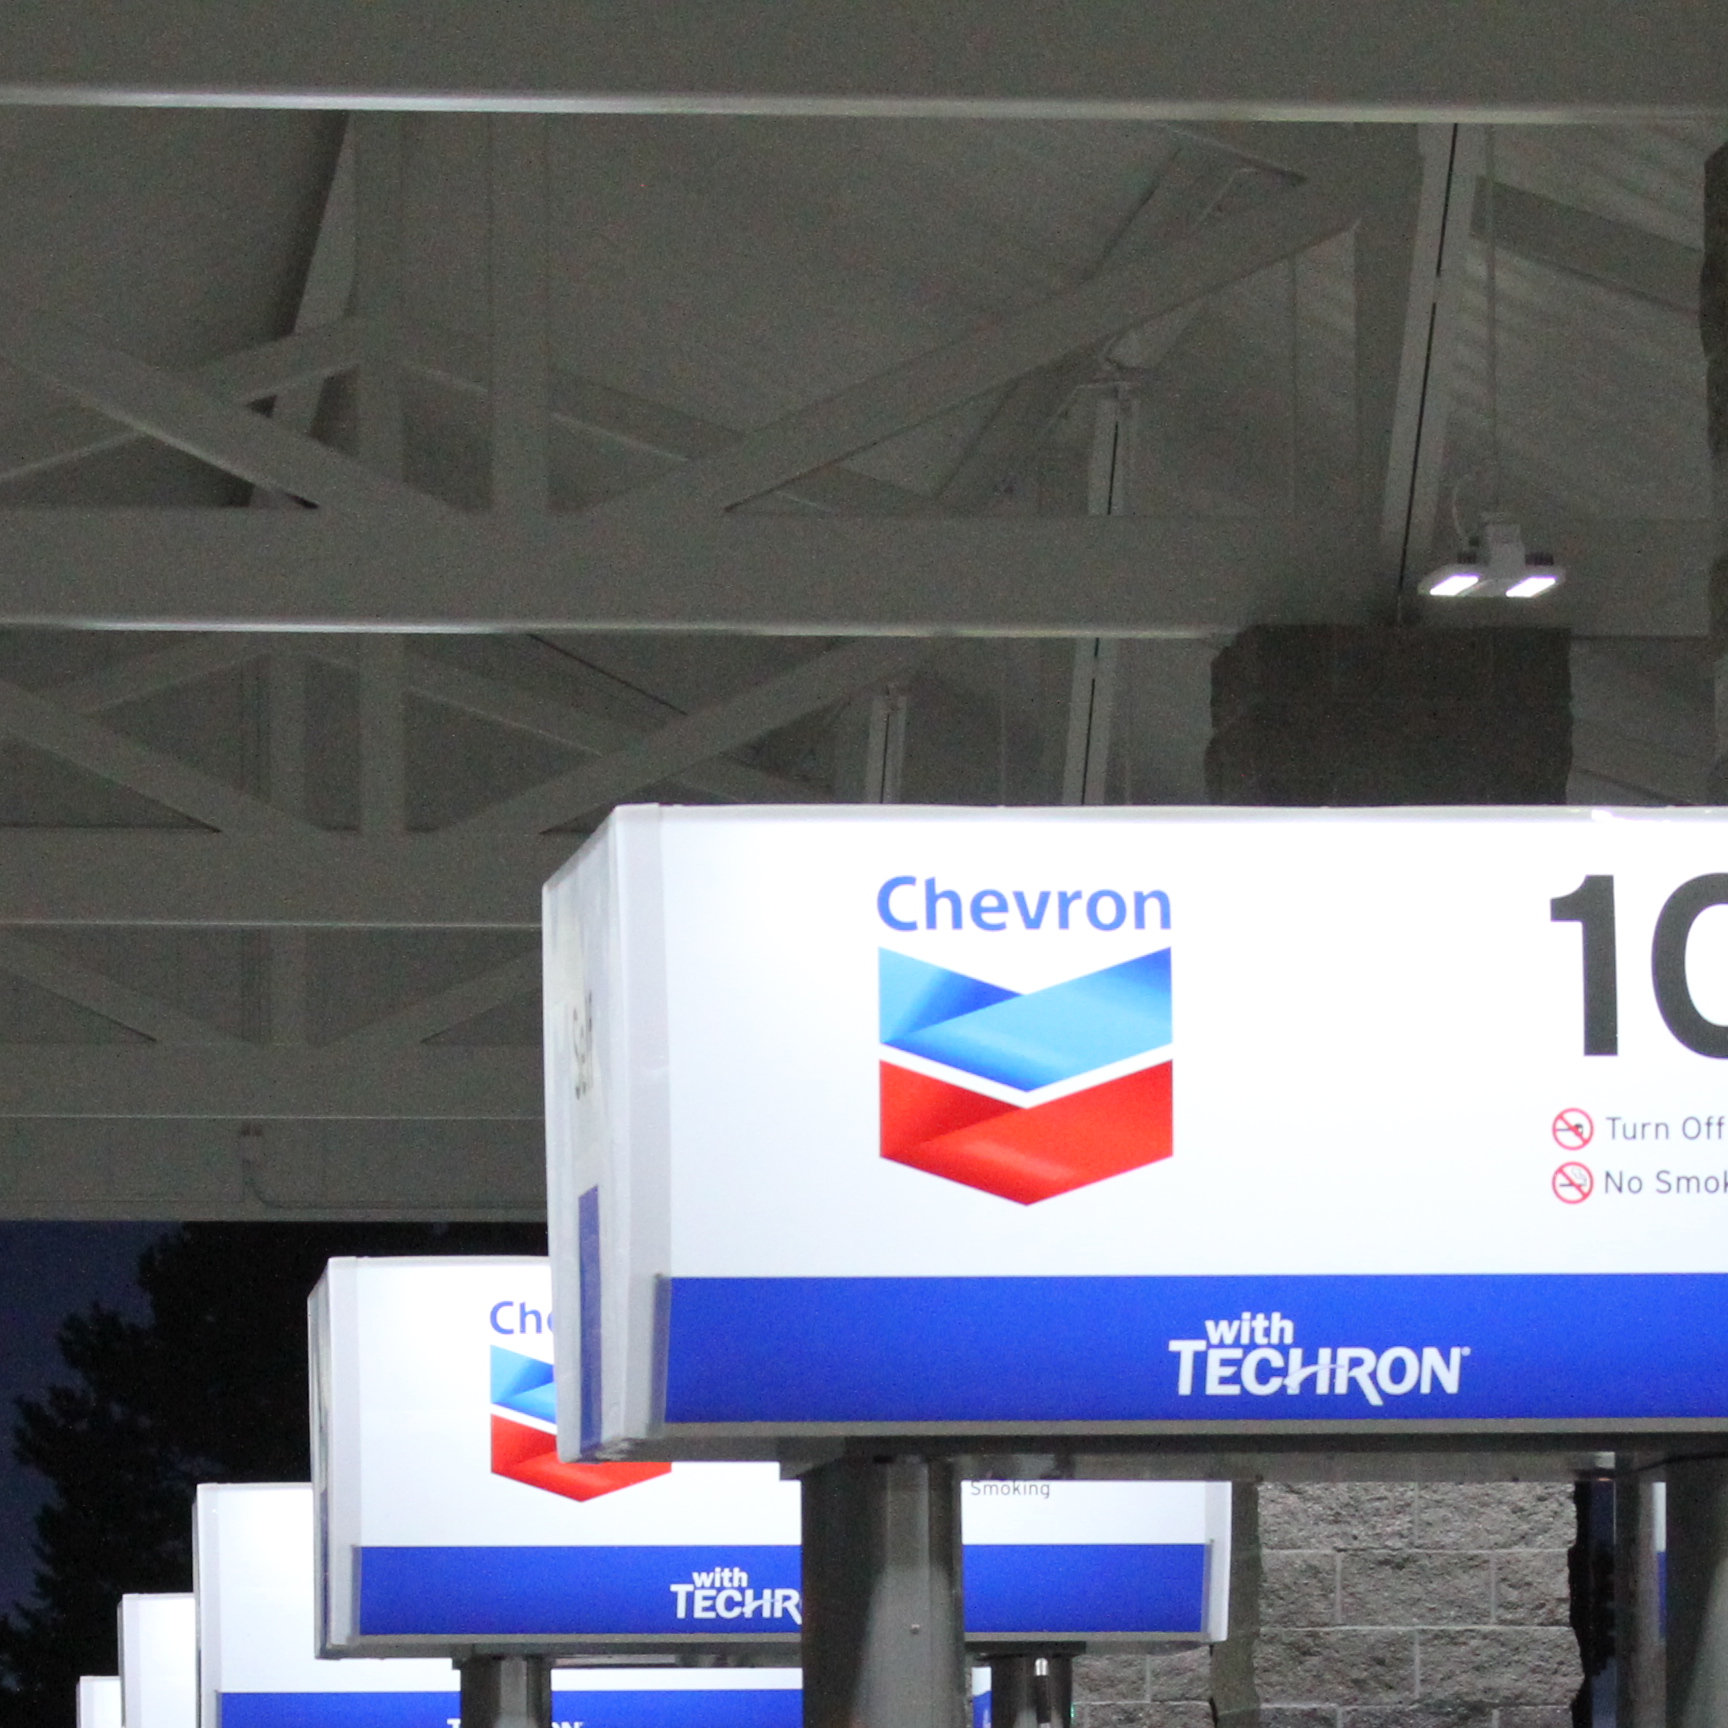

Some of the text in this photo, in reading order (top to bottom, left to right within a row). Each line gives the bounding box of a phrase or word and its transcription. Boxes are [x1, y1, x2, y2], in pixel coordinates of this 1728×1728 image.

[877, 876, 1172, 933] Chevron
[1606, 1113, 1671, 1143] Turn
[1682, 1113, 1727, 1143] Off
[1604, 1168, 1642, 1197] No
[1206, 1313, 1295, 1346] with
[1168, 1340, 1462, 1405] TECHRON
[971, 1481, 1050, 1499] Smoking
[692, 1566, 748, 1588] with
[671, 1584, 803, 1625] TECHR
